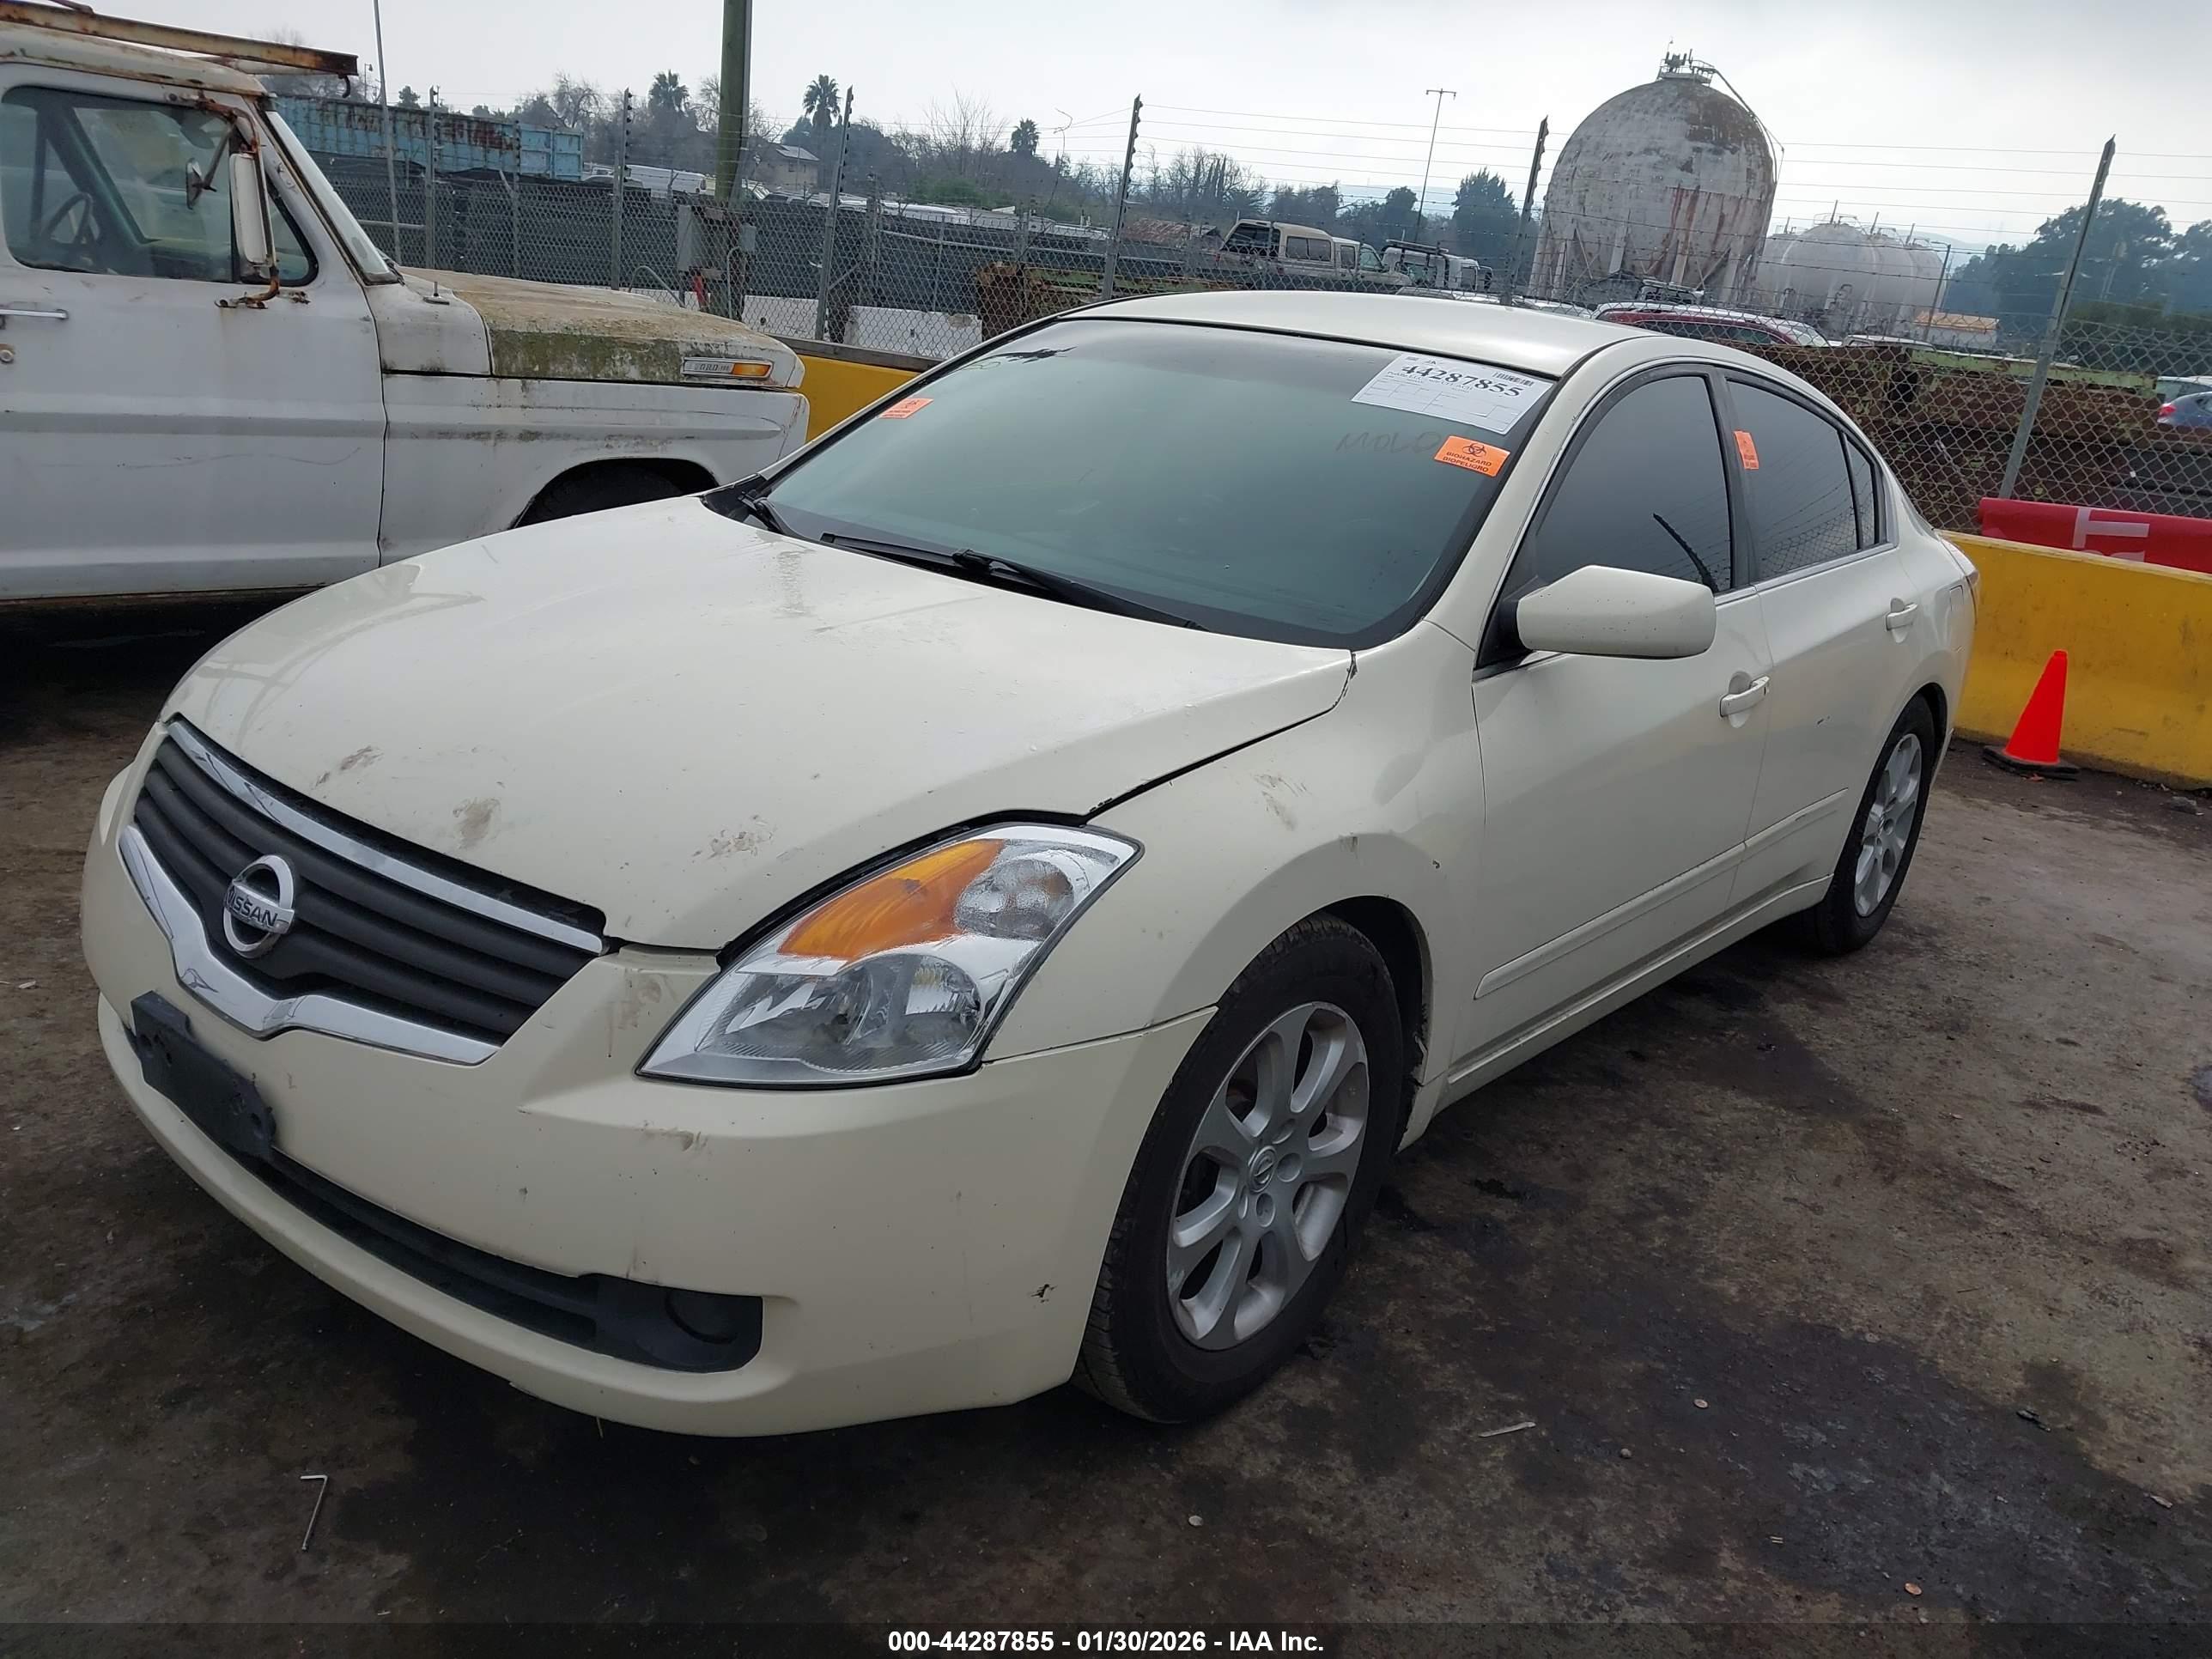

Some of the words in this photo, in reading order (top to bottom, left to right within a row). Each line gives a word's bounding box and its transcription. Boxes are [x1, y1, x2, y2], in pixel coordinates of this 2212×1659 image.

[1401, 365, 1524, 398] 44287855
[1443, 456, 1489, 472] BIOPELIGRO
[1446, 452, 1492, 467] BIOHAZARD
[226, 888, 278, 927] NISSAN
